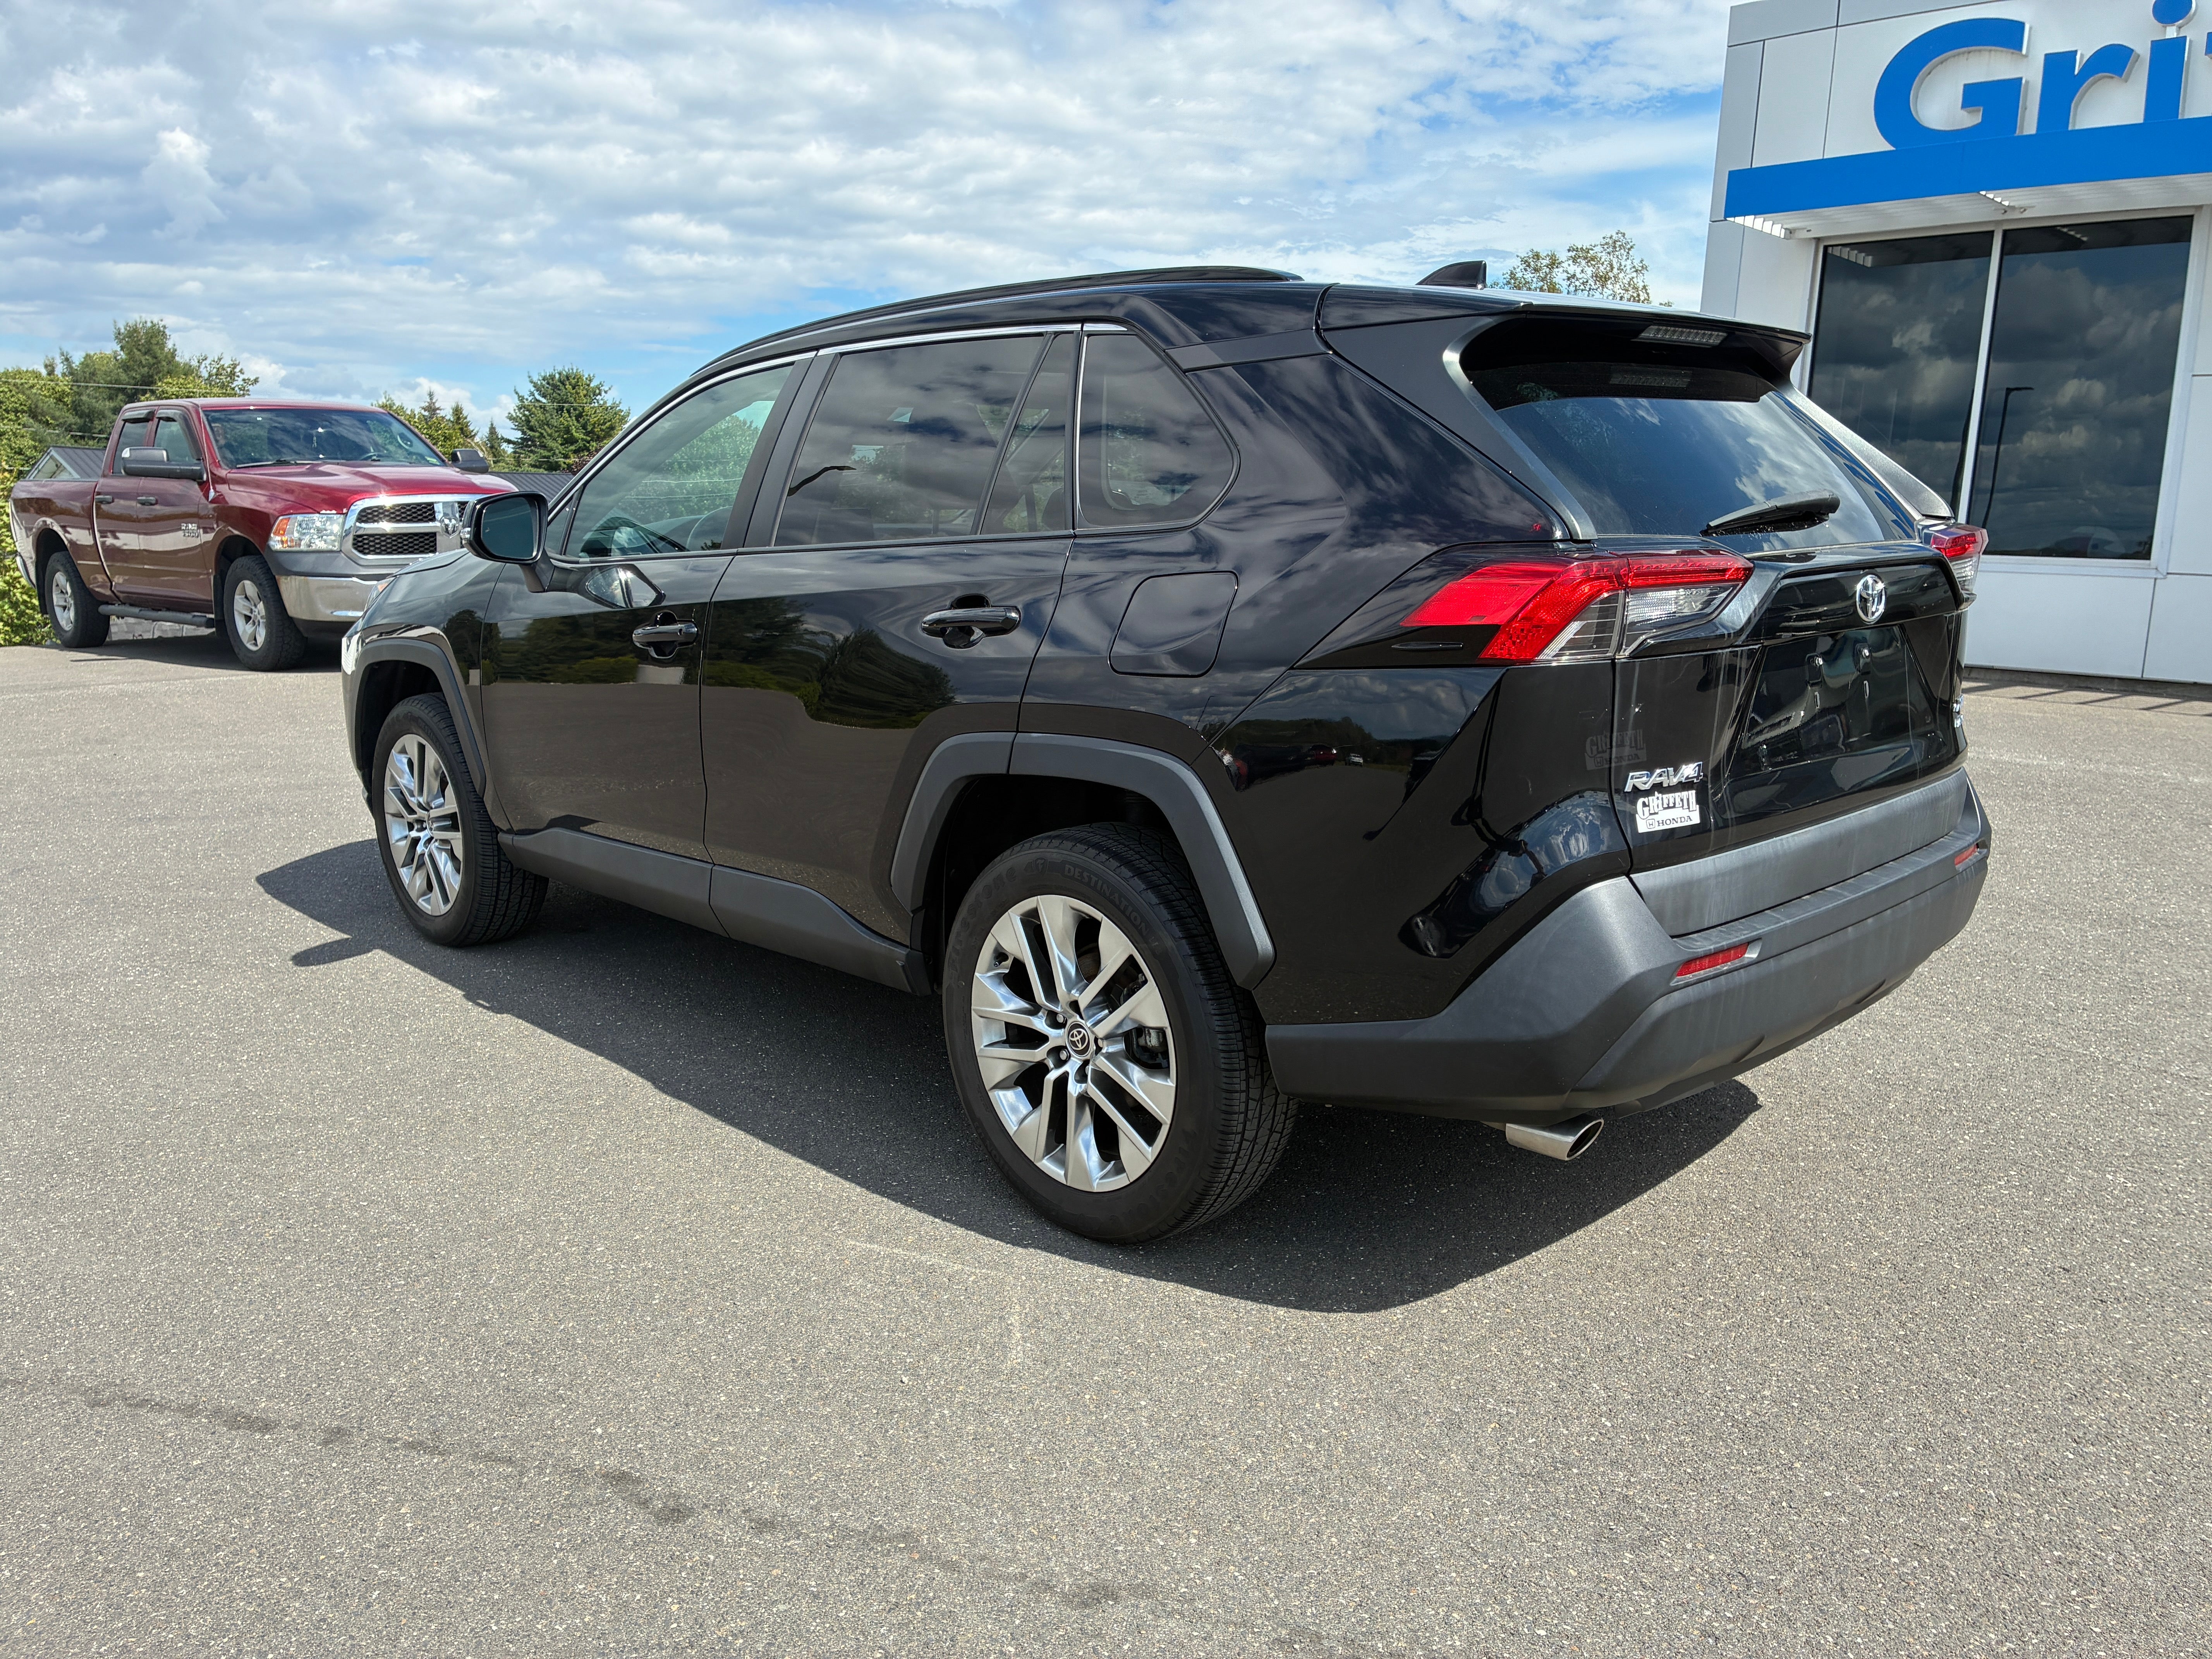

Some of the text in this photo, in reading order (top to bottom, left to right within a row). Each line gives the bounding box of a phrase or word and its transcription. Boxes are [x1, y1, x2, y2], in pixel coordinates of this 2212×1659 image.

[1874, 0, 2212, 149] Gri
[1624, 762, 1703, 792] RAV4
[1657, 816, 1693, 827] HONDA
[1064, 864, 1150, 936] DESTINATION
